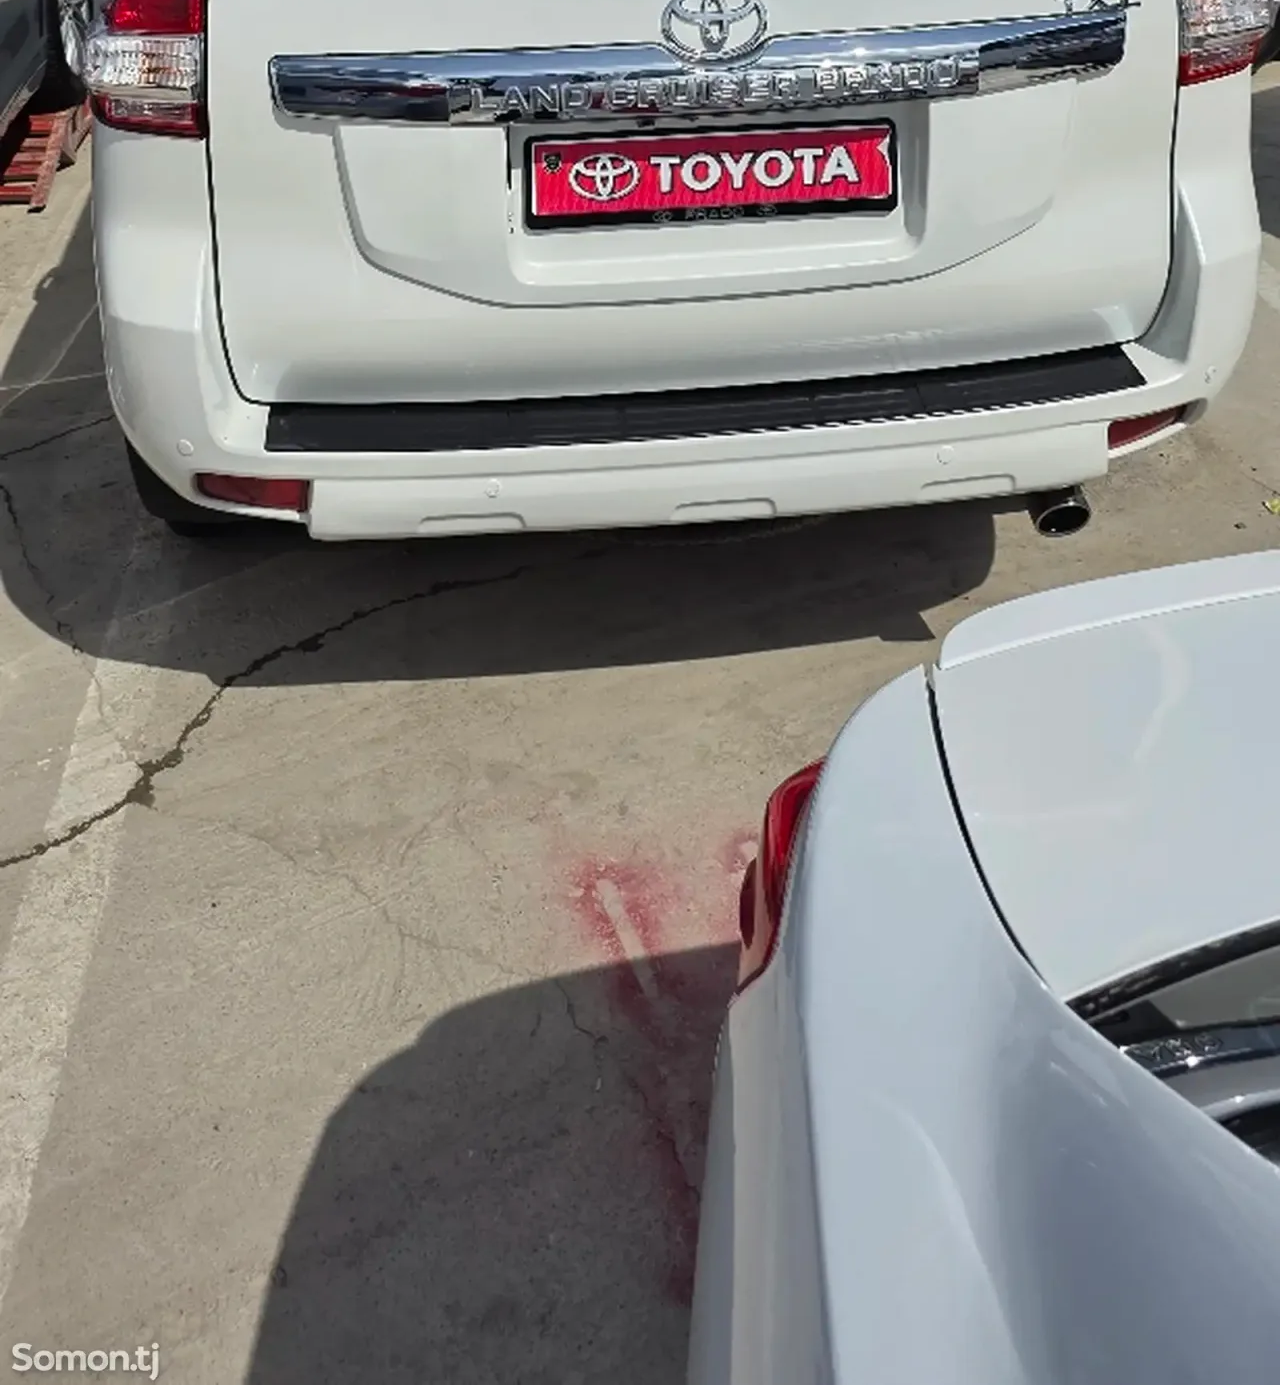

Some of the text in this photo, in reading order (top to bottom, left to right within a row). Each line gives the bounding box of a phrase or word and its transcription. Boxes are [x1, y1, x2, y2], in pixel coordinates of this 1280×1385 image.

[470, 59, 962, 115] LAND CRUISER PRADO
[649, 145, 860, 193] TOYOTA
